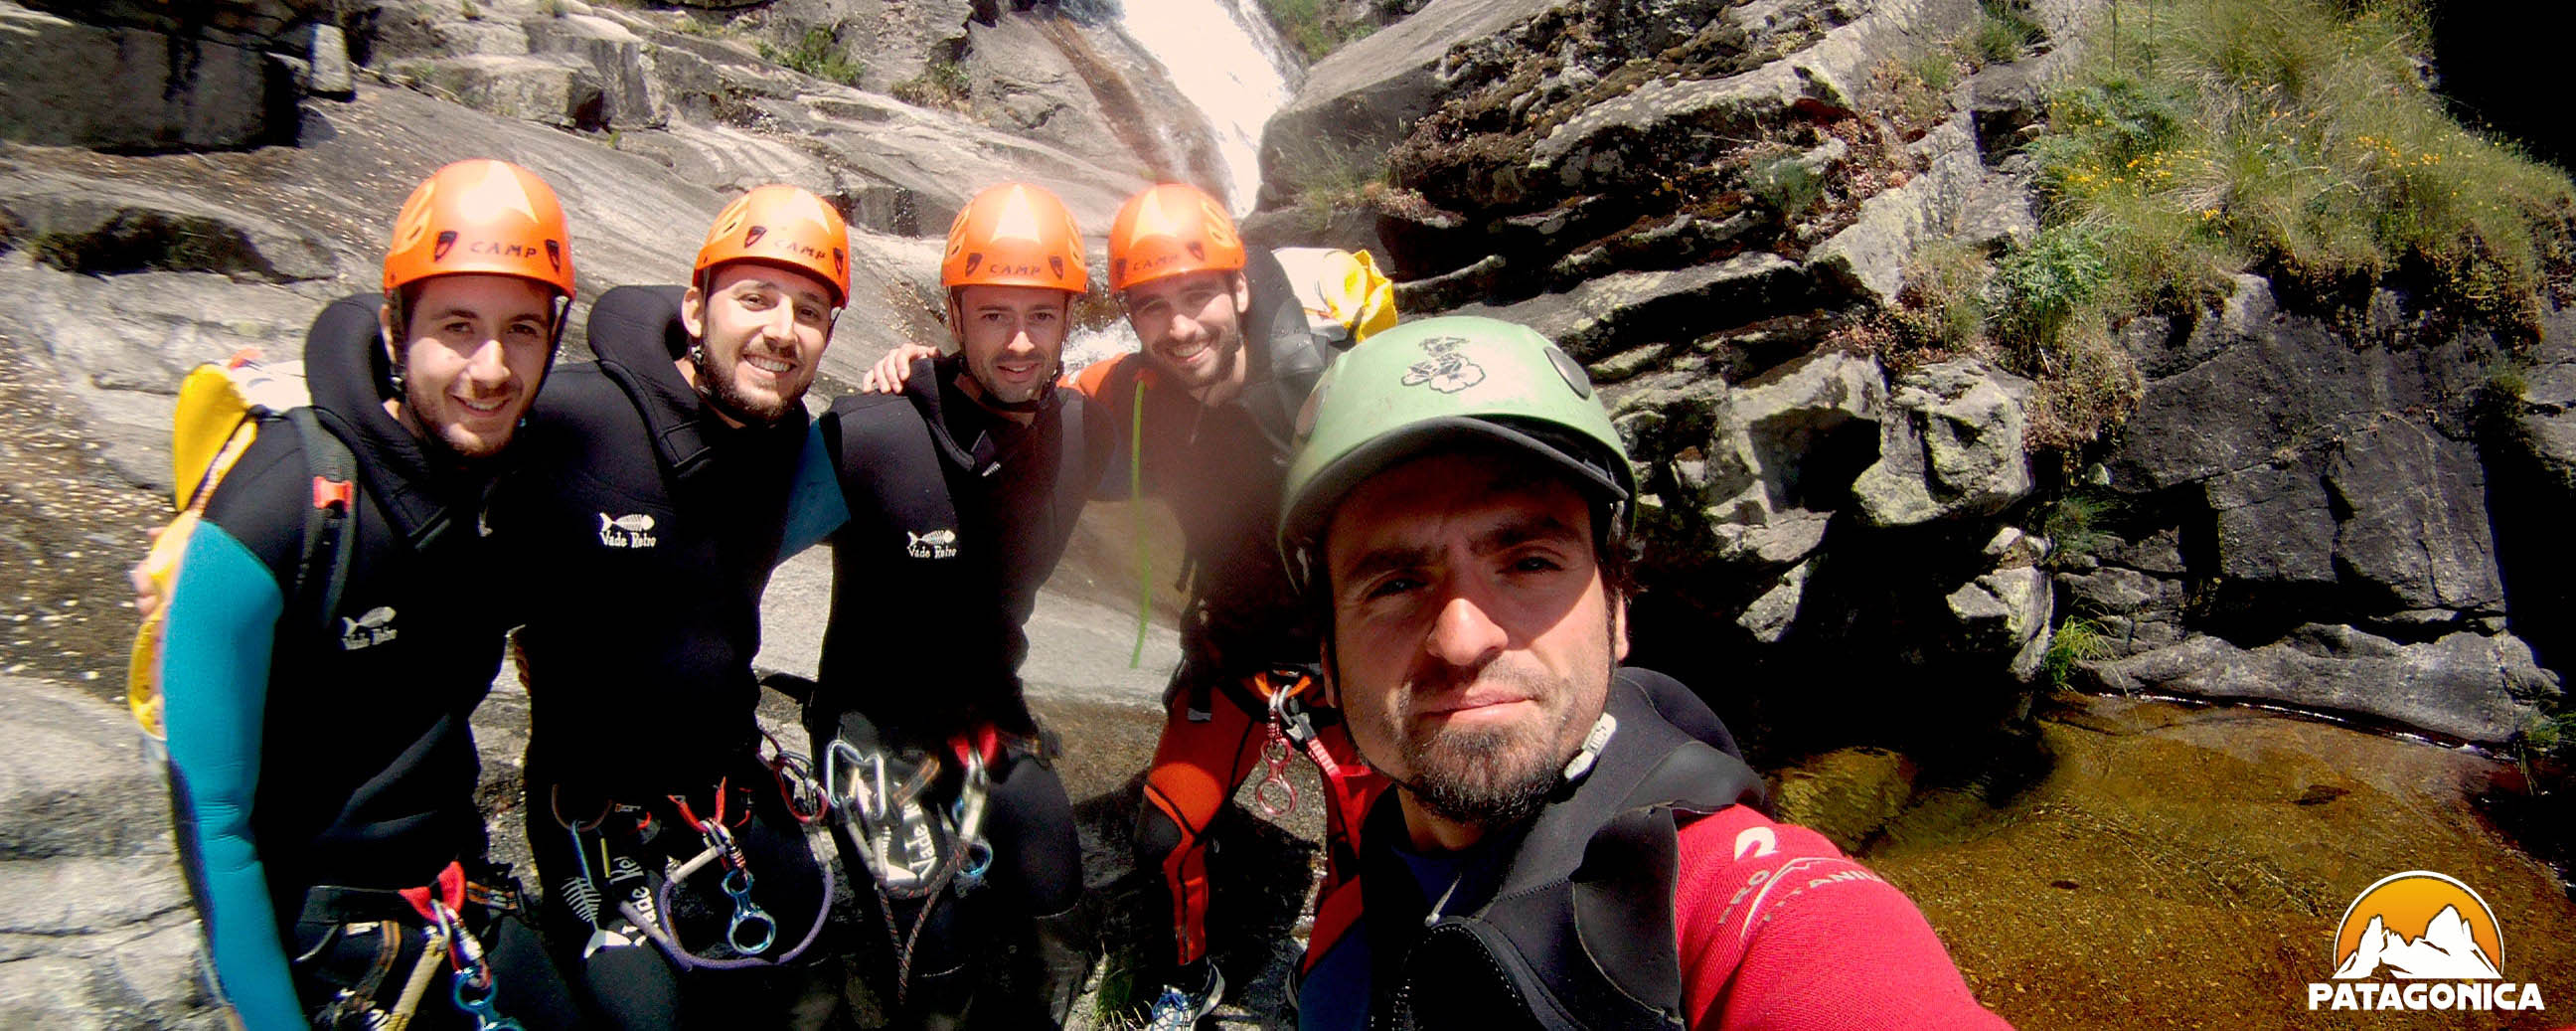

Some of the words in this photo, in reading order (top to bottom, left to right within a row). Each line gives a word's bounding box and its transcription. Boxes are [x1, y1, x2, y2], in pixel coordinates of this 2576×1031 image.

[469, 241, 538, 258] CAMP
[774, 239, 826, 259] CAMP
[990, 264, 1041, 275] CAMP
[599, 530, 628, 548] Vade
